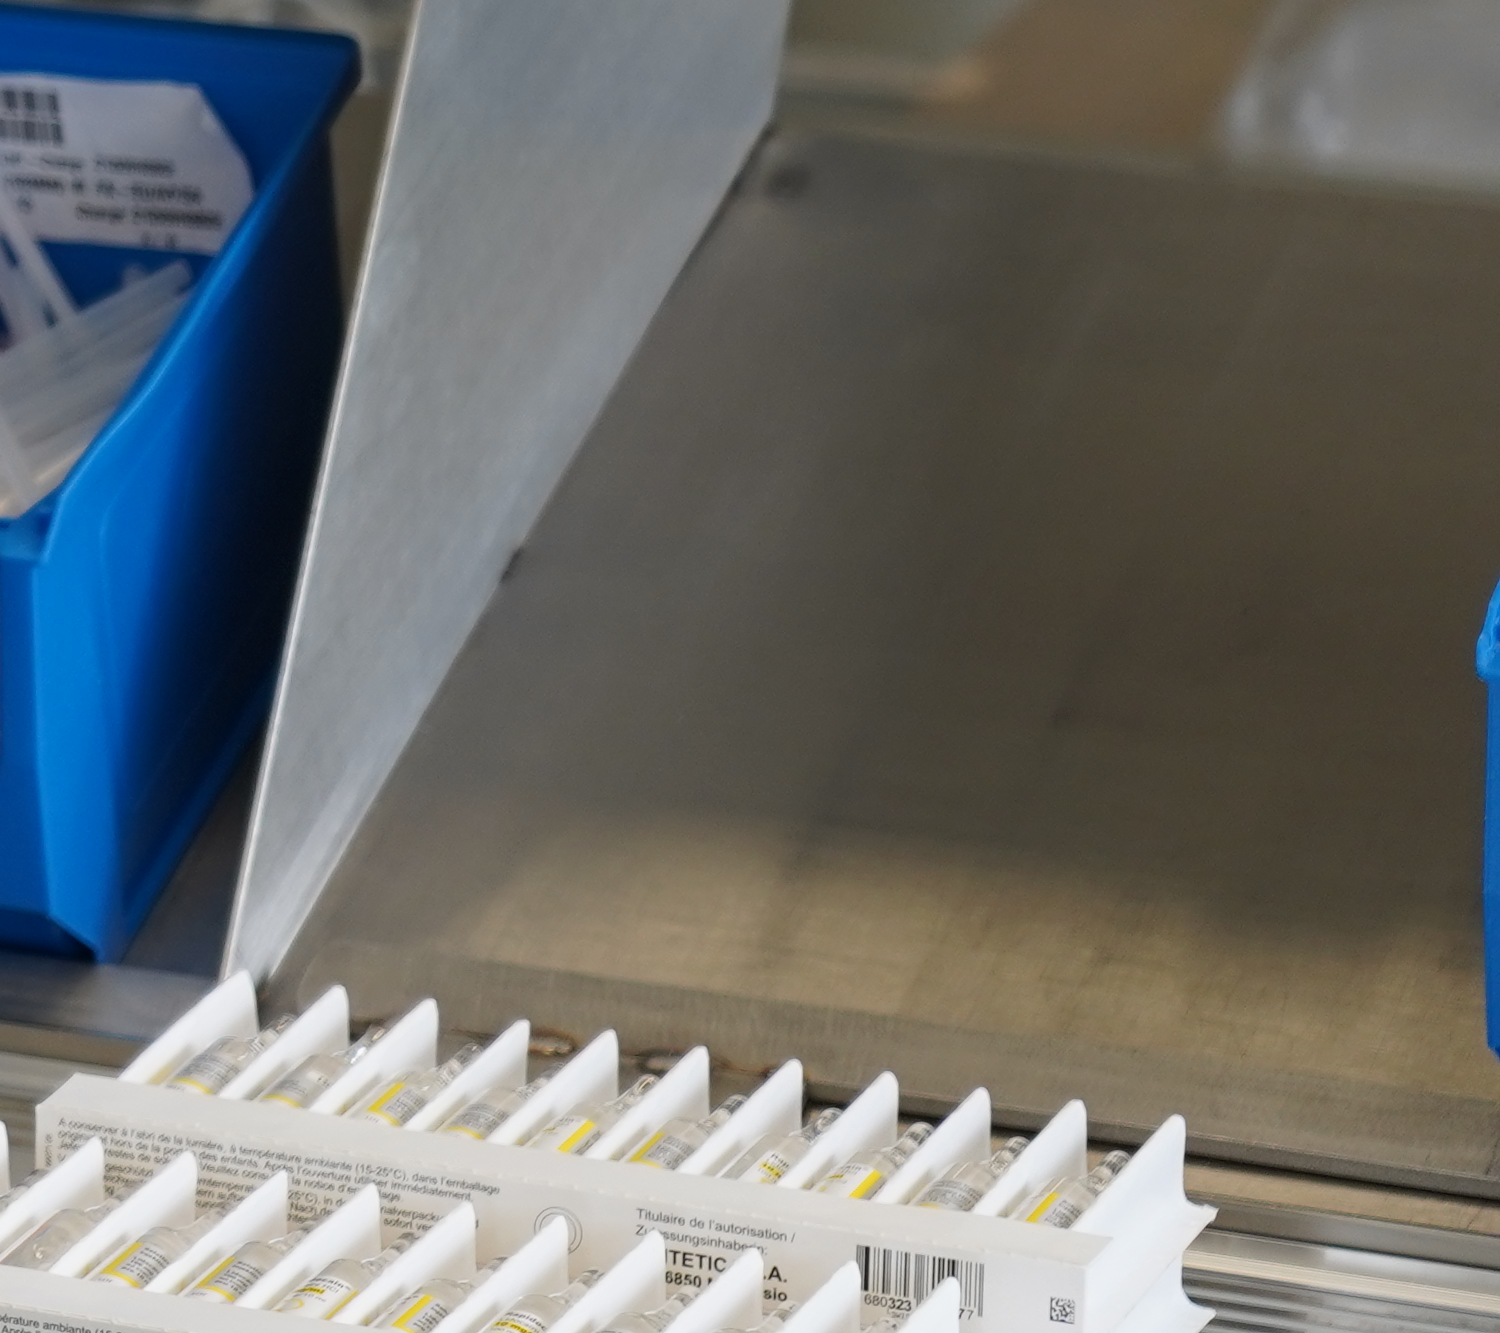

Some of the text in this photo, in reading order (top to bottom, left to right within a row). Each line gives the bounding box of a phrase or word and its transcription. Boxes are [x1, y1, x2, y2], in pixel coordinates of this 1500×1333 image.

[412, 1172, 437, 1185] dans
[636, 1208, 685, 1226] Titulaire
[689, 1216, 704, 1229] de
[709, 1220, 787, 1242] l'autorisation
[864, 1294, 912, 1312] 680323
